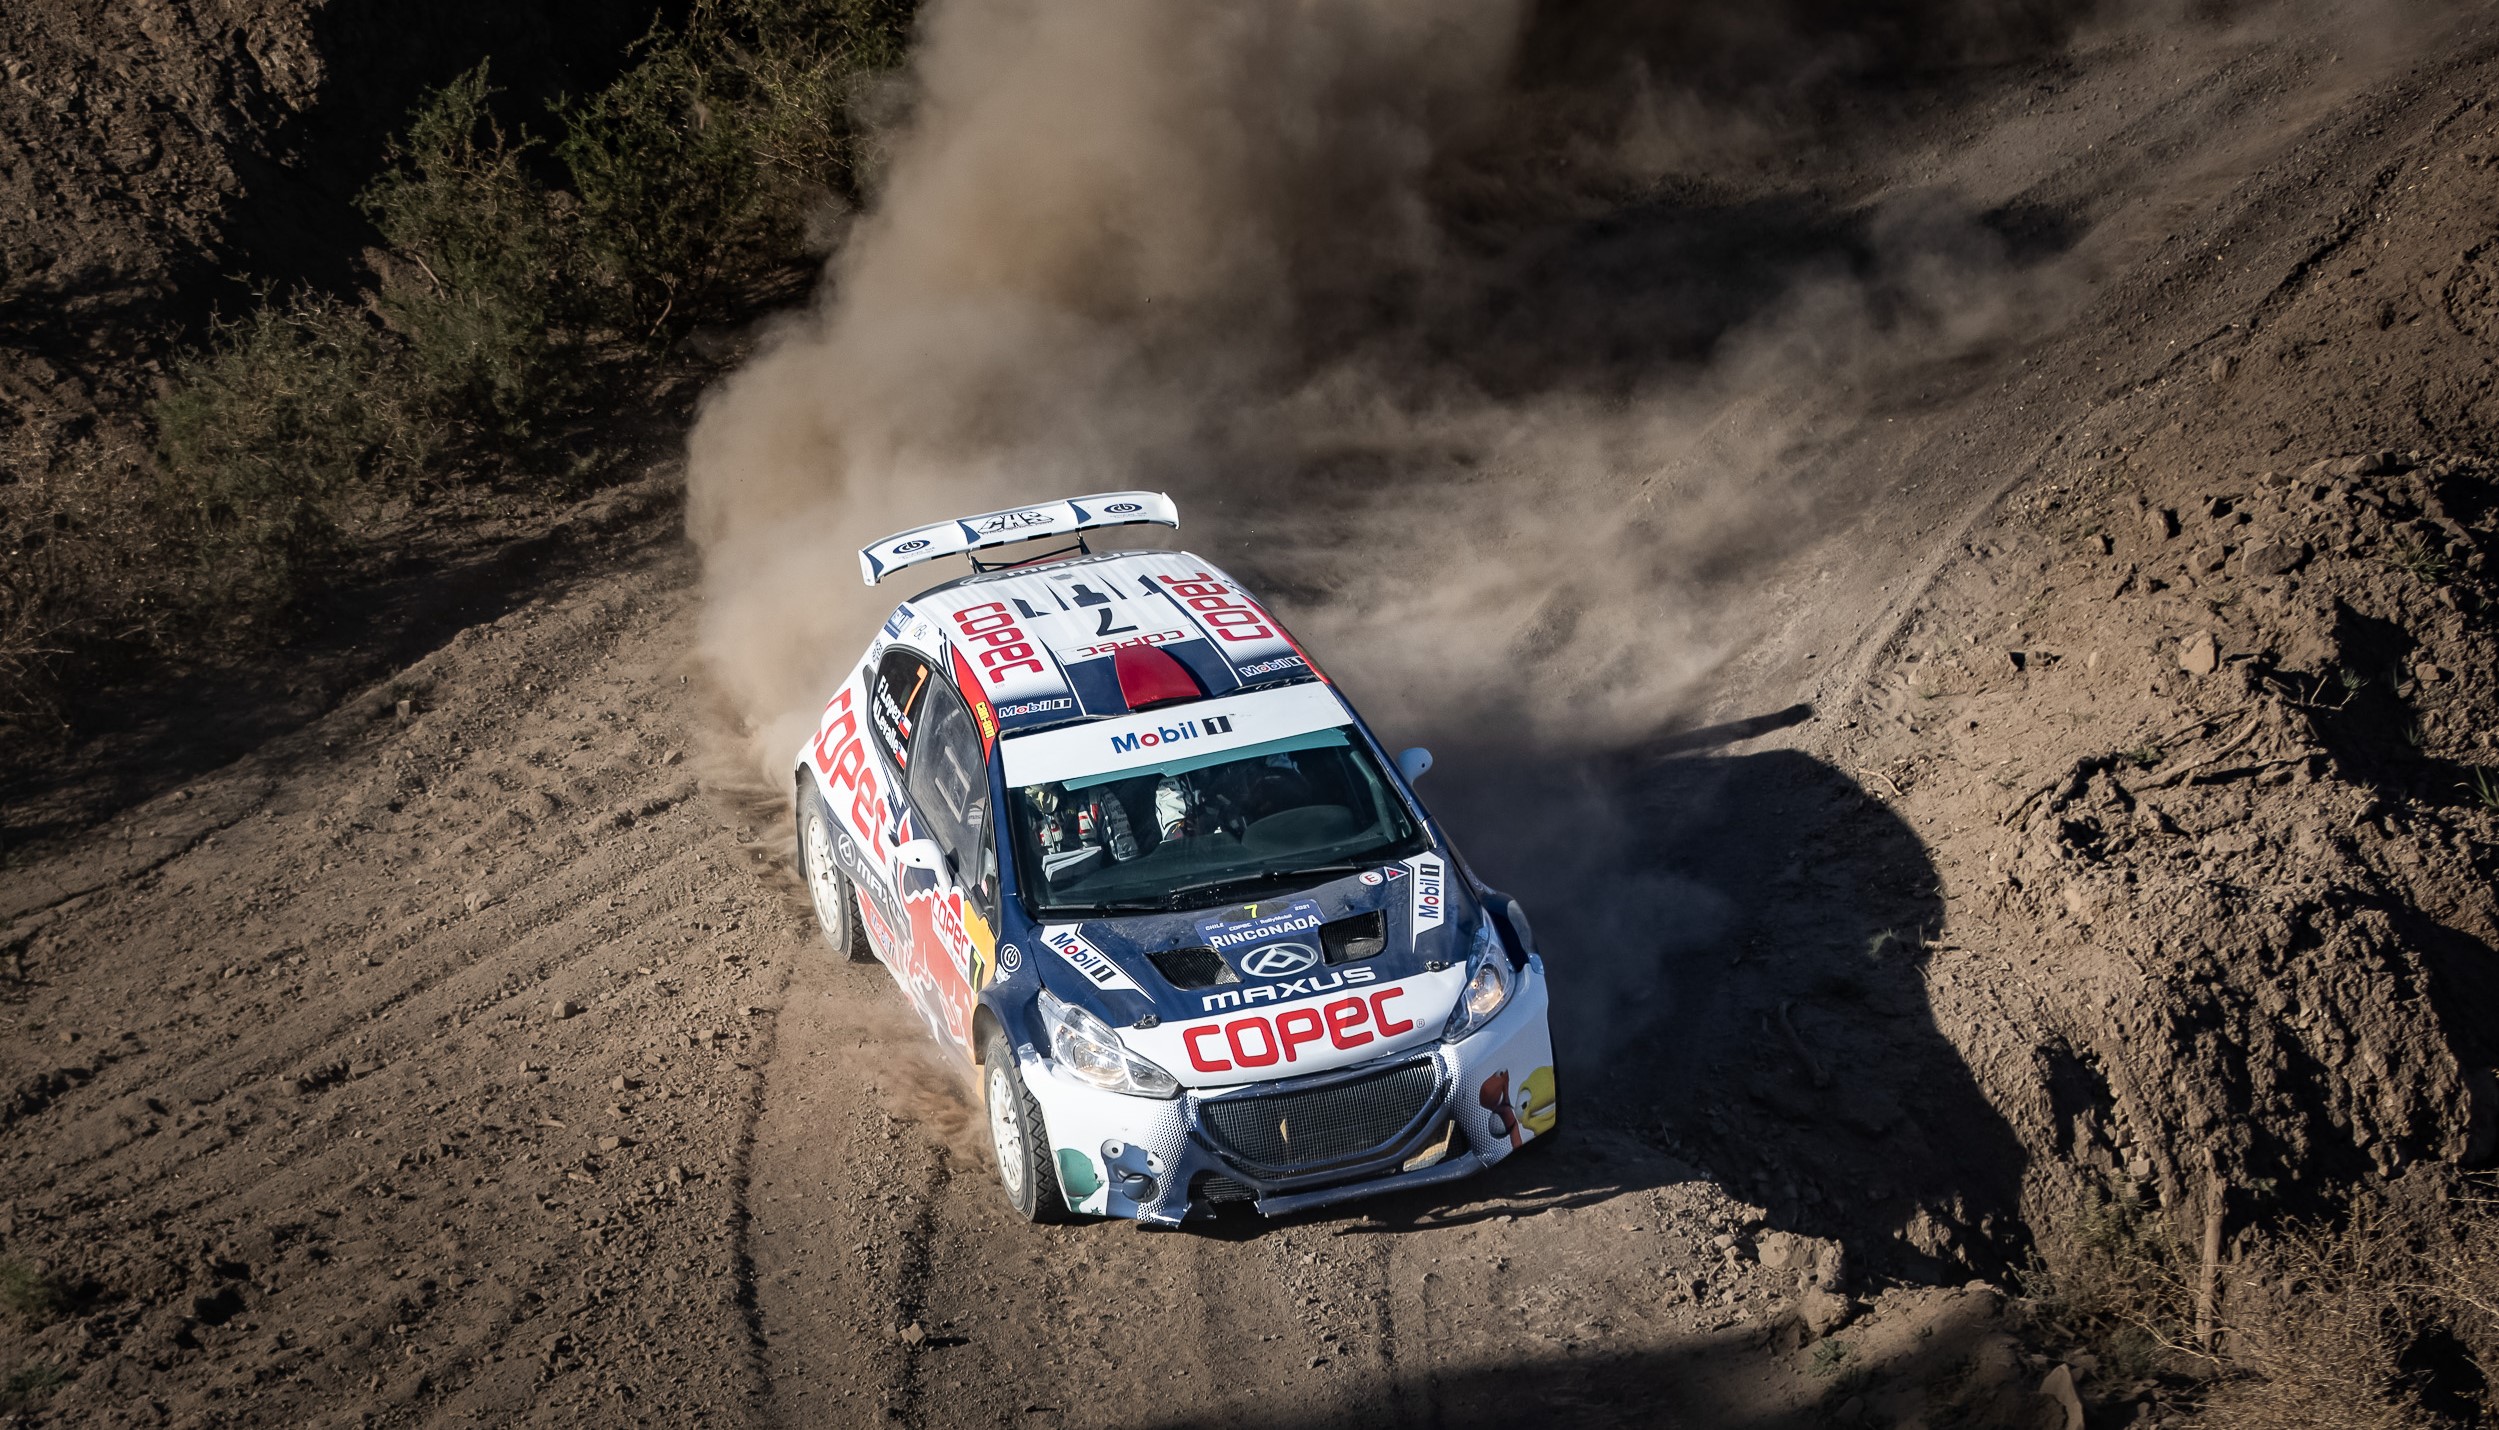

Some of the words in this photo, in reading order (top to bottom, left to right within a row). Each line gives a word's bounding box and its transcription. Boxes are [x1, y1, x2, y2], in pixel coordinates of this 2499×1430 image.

[1095, 607, 1139, 637] 7
[952, 601, 1044, 684] COPEC
[1239, 658, 1289, 678] Mobil
[998, 700, 1052, 718] Mobil
[1110, 720, 1199, 754] Mobil
[1201, 715, 1233, 736] 1
[1419, 863, 1440, 877] 1
[1243, 903, 1258, 919] 7
[1418, 878, 1440, 919] Mobil
[1205, 922, 1225, 931] CHILE
[1208, 914, 1322, 949] RINCONADA
[1049, 932, 1102, 971] Mobil
[1089, 964, 1117, 983] 1
[1201, 966, 1377, 1012] MAXUS
[1182, 986, 1414, 1073] COPEC
